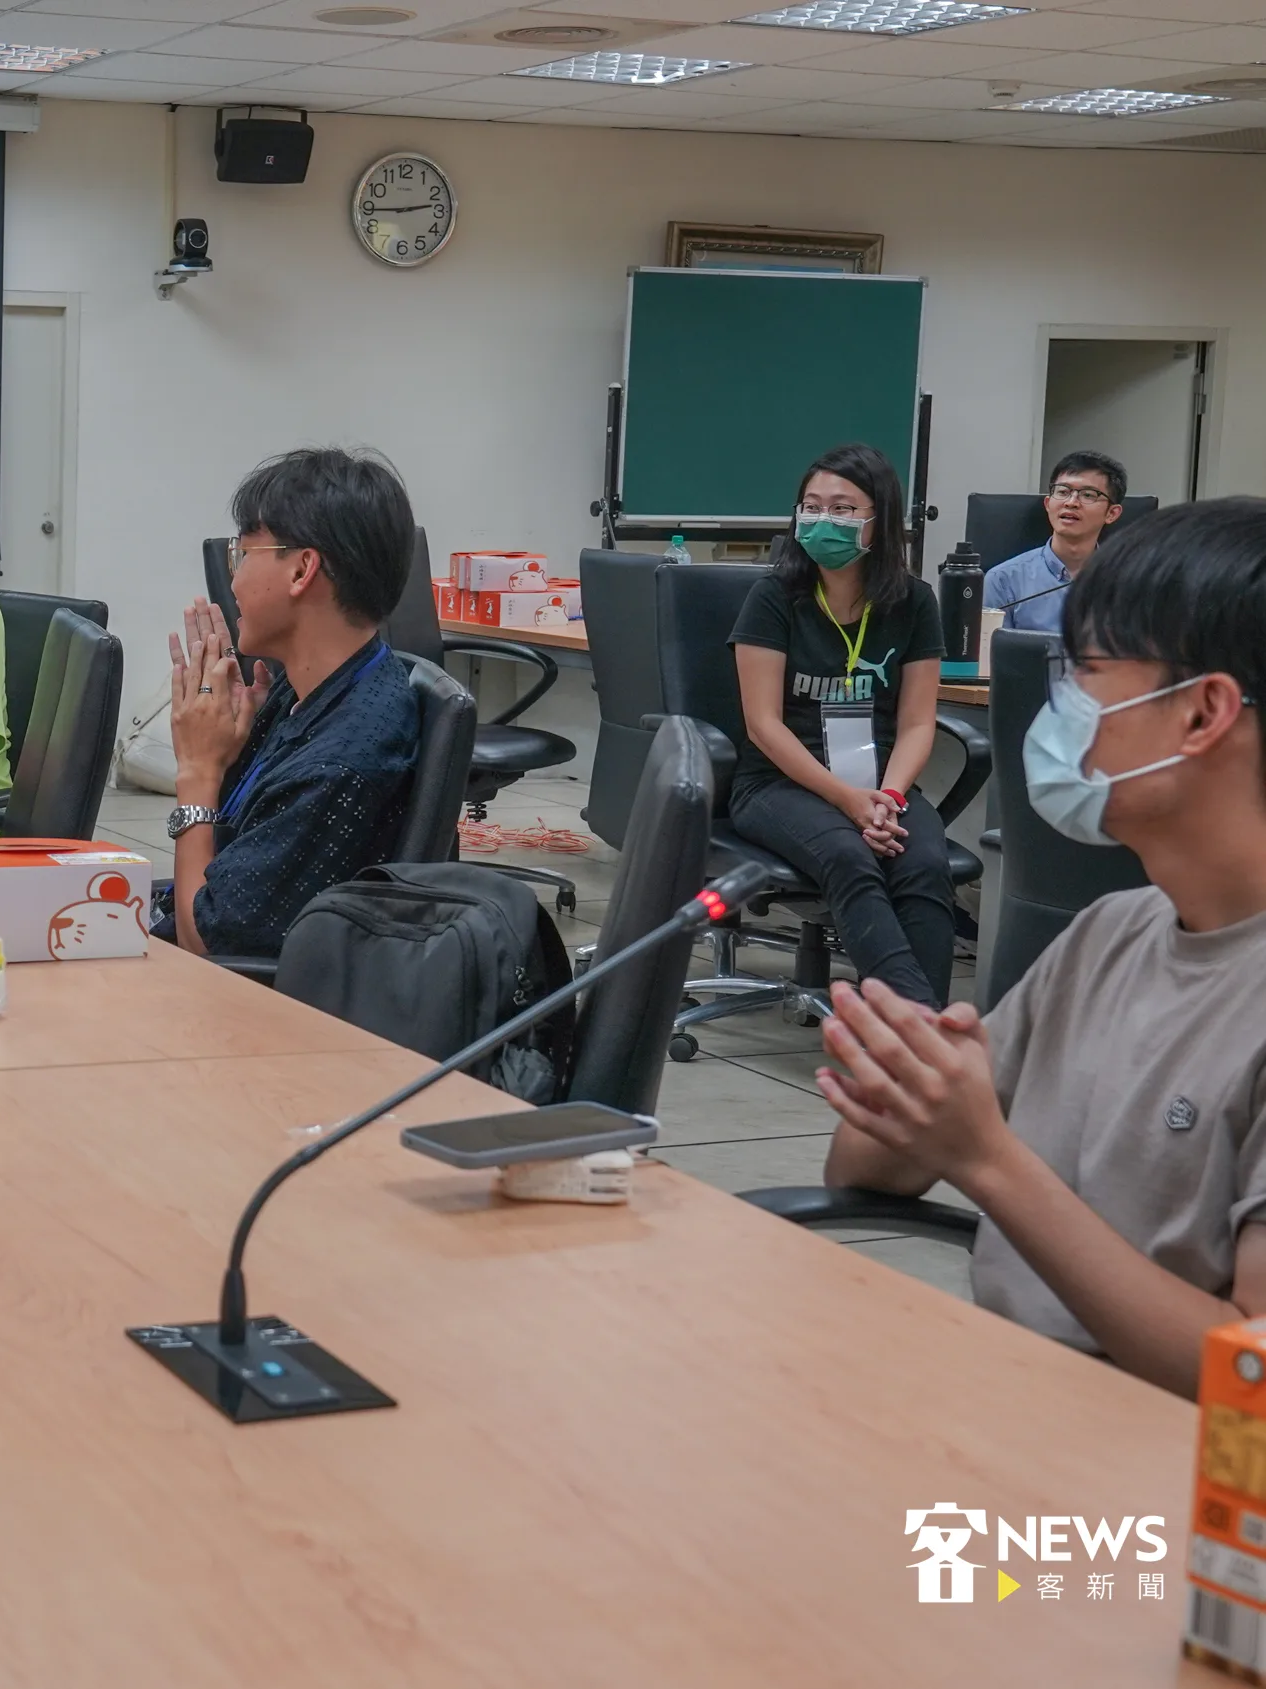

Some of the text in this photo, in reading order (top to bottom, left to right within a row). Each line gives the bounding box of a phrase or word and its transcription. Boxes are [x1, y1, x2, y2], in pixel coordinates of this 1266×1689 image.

[383, 168, 395, 183] 11
[398, 164, 414, 179] 12
[420, 170, 426, 185] 1
[369, 183, 387, 198] 10
[429, 186, 441, 201] 2
[362, 200, 375, 216] 9
[433, 203, 445, 219] 3
[366, 218, 379, 234] 8
[428, 222, 440, 236] 4
[379, 234, 391, 249] 7
[396, 240, 409, 256] 6
[414, 235, 426, 251] 5
[792, 671, 873, 702] PUMA
